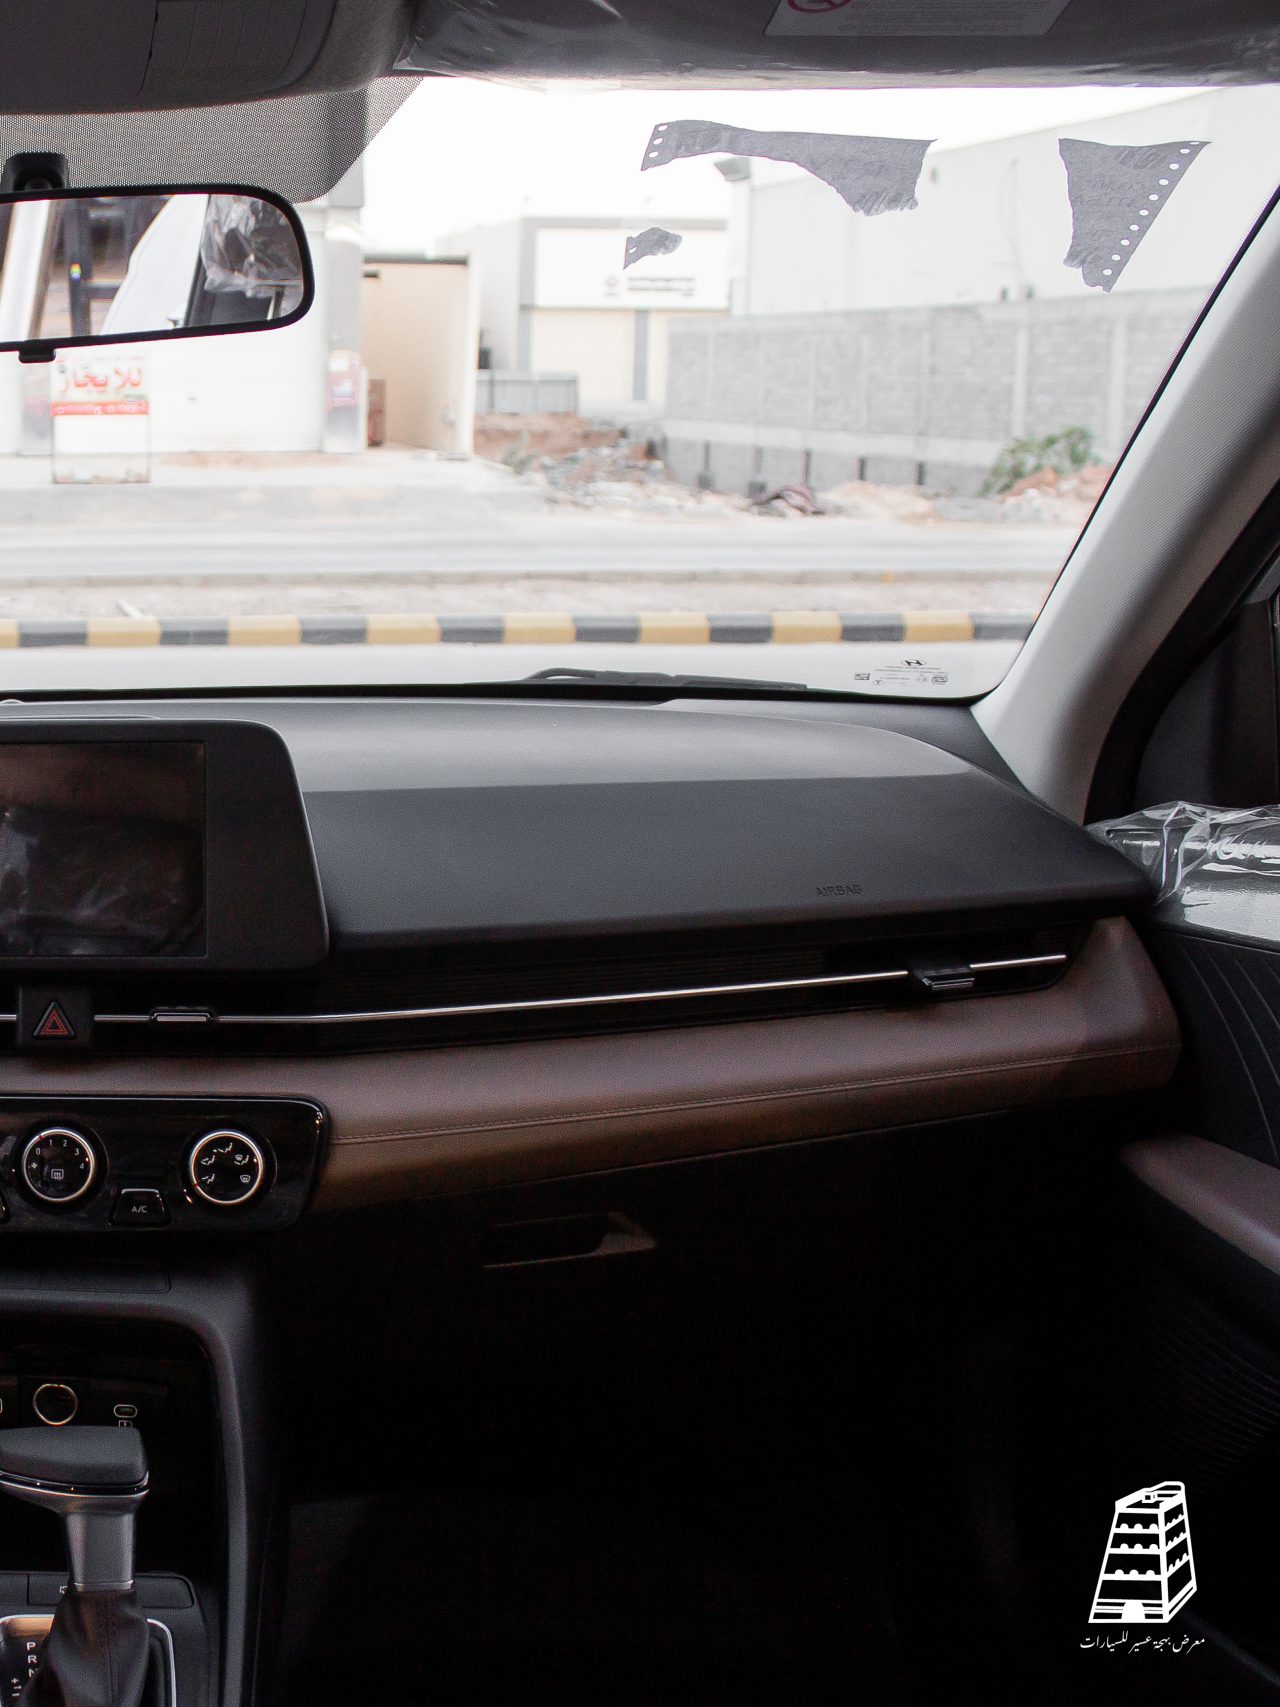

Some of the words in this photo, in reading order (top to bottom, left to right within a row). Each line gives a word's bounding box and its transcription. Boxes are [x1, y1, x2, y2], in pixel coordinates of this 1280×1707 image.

[815, 883, 863, 897] AIRBAG
[131, 1205, 148, 1213] A/C
[26, 1641, 36, 1651] P
[27, 1654, 38, 1664] R
